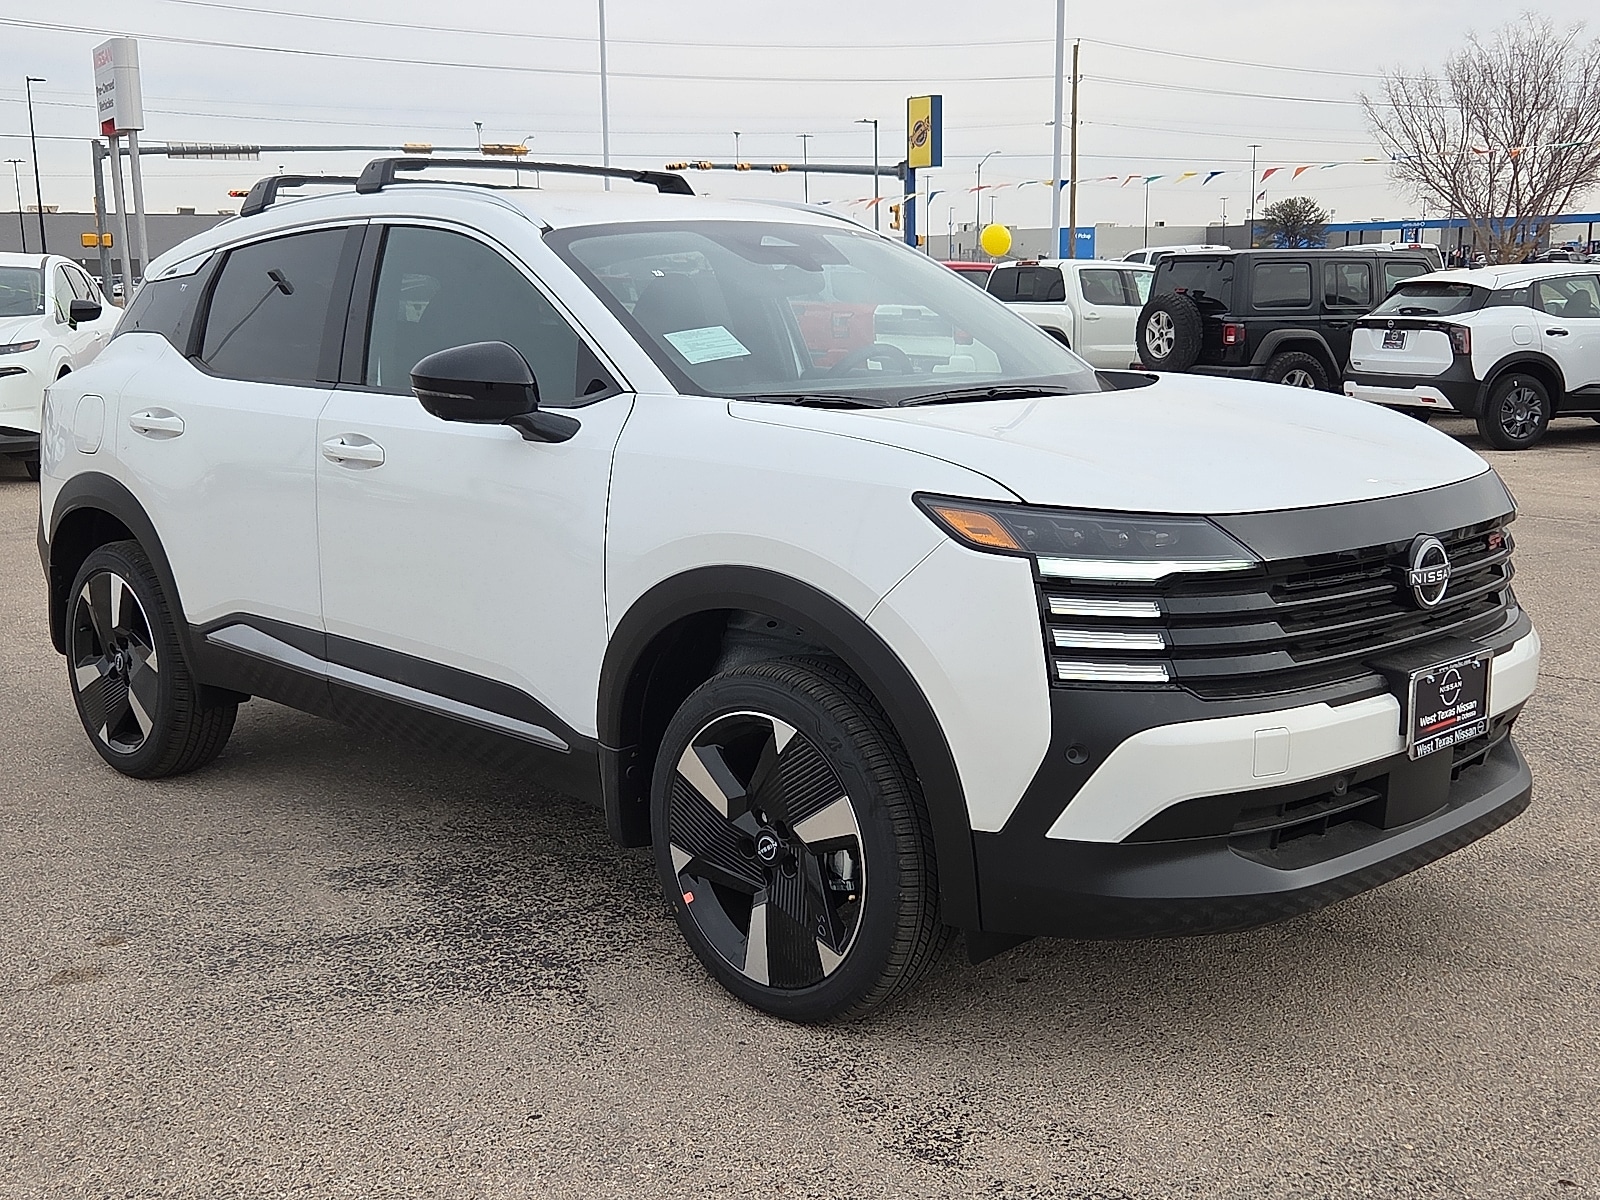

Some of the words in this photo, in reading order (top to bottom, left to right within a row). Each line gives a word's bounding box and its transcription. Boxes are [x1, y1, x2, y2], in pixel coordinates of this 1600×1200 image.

[1411, 568, 1450, 584] NISSA
[1440, 680, 1463, 693] NISSAN
[1420, 713, 1437, 728] West
[1437, 707, 1456, 721] Texas
[1456, 700, 1478, 714] Nissan
[1416, 741, 1434, 757] West
[1434, 734, 1454, 750] Texas
[1454, 726, 1477, 741] Nissan
